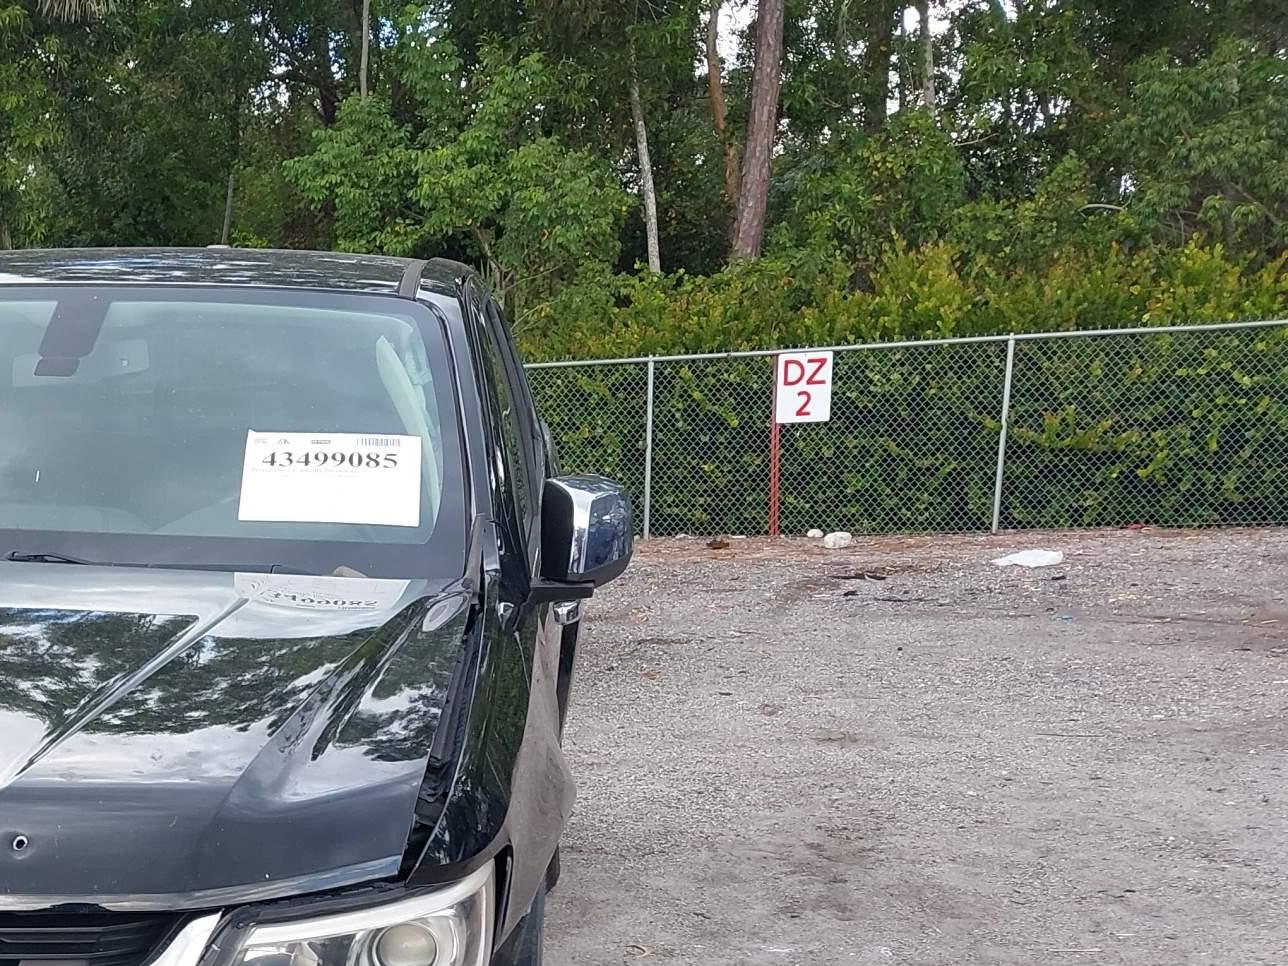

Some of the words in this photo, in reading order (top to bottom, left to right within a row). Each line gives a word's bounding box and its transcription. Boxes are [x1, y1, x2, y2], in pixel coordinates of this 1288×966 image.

[783, 357, 828, 386] DZ
[795, 390, 812, 417] 2
[261, 451, 398, 469] 43499085
